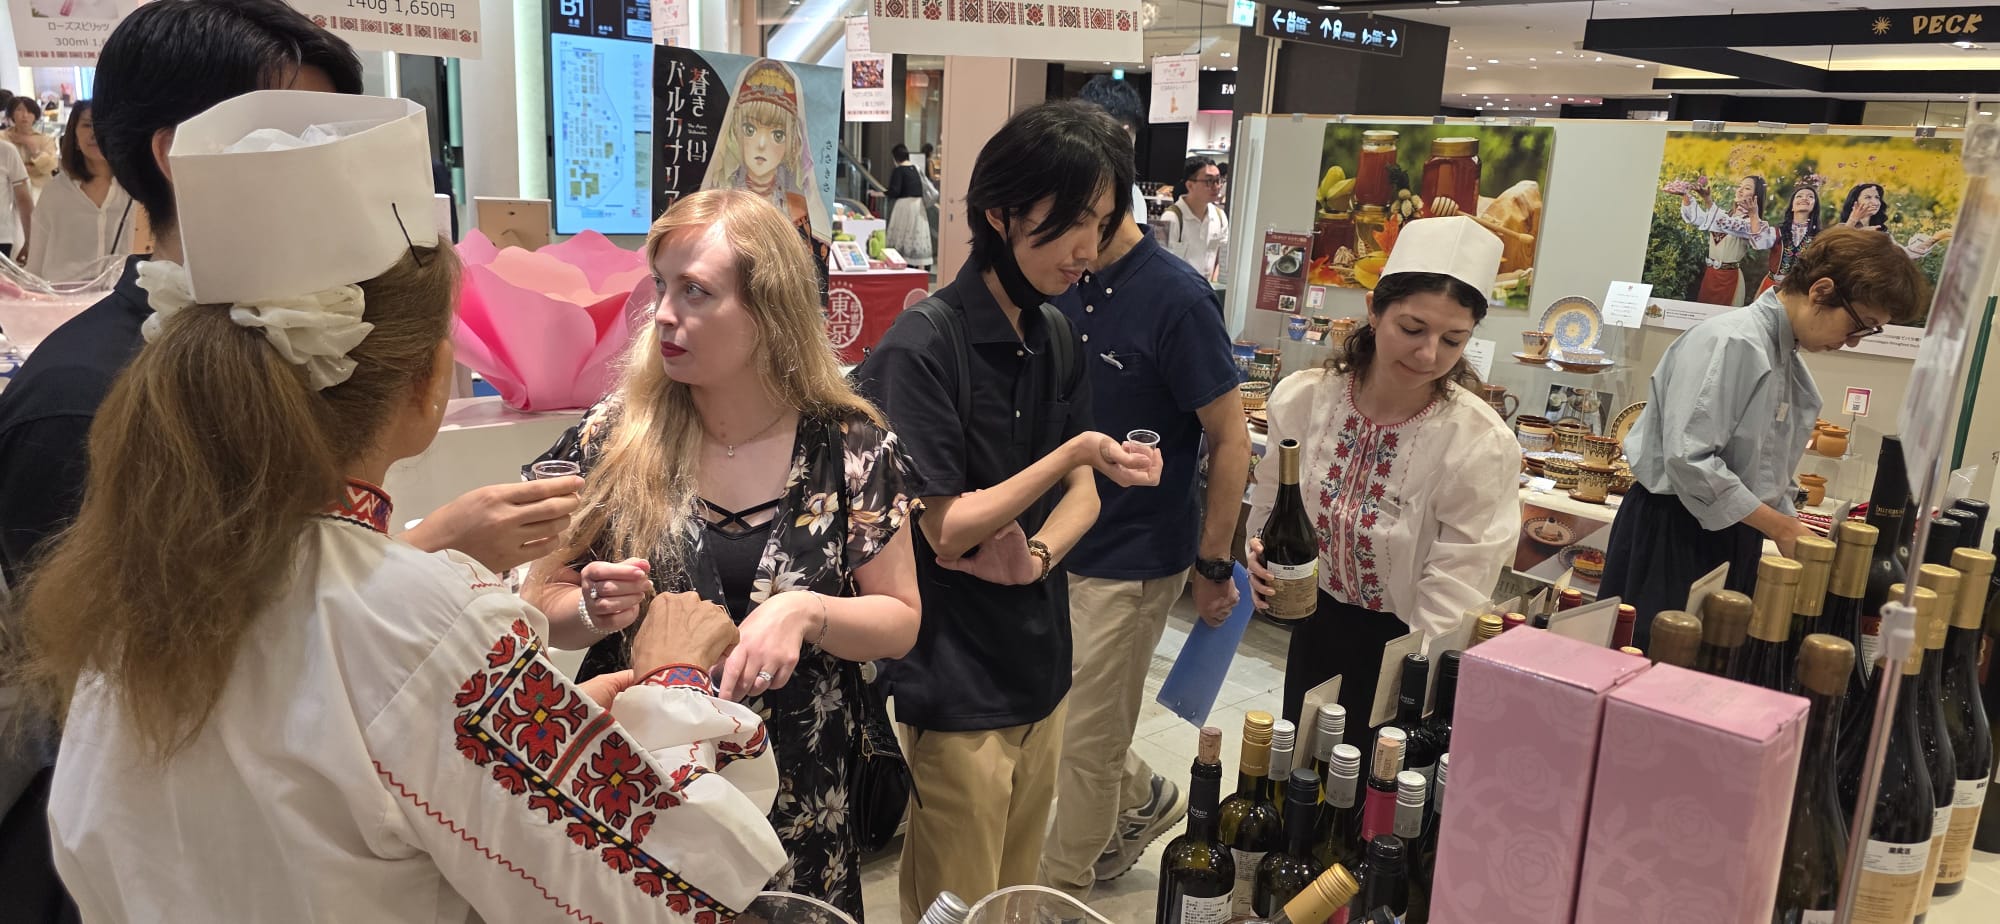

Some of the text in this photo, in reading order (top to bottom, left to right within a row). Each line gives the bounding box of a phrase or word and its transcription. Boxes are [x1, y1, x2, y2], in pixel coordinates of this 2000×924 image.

[394, 0, 455, 19] 1,650円
[560, 0, 585, 17] B1
[1912, 14, 1983, 35] PECK
[56, 37, 89, 47] 300ml
[689, 67, 710, 118] 蒼き
